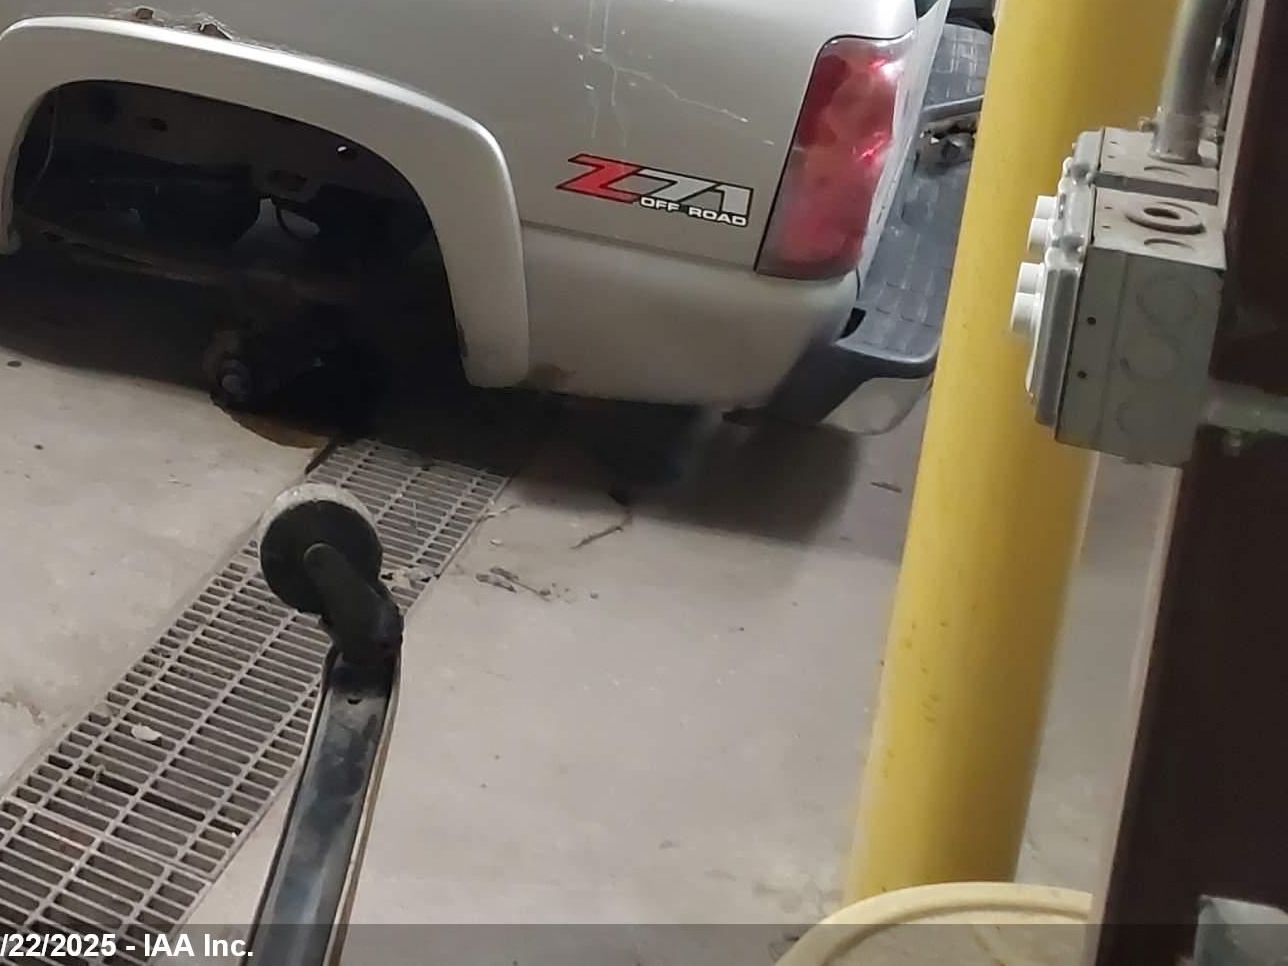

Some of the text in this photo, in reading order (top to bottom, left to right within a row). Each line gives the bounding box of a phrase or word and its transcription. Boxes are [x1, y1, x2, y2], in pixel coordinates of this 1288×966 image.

[556, 153, 753, 216] Z71
[640, 196, 748, 227] OFF ROAD
